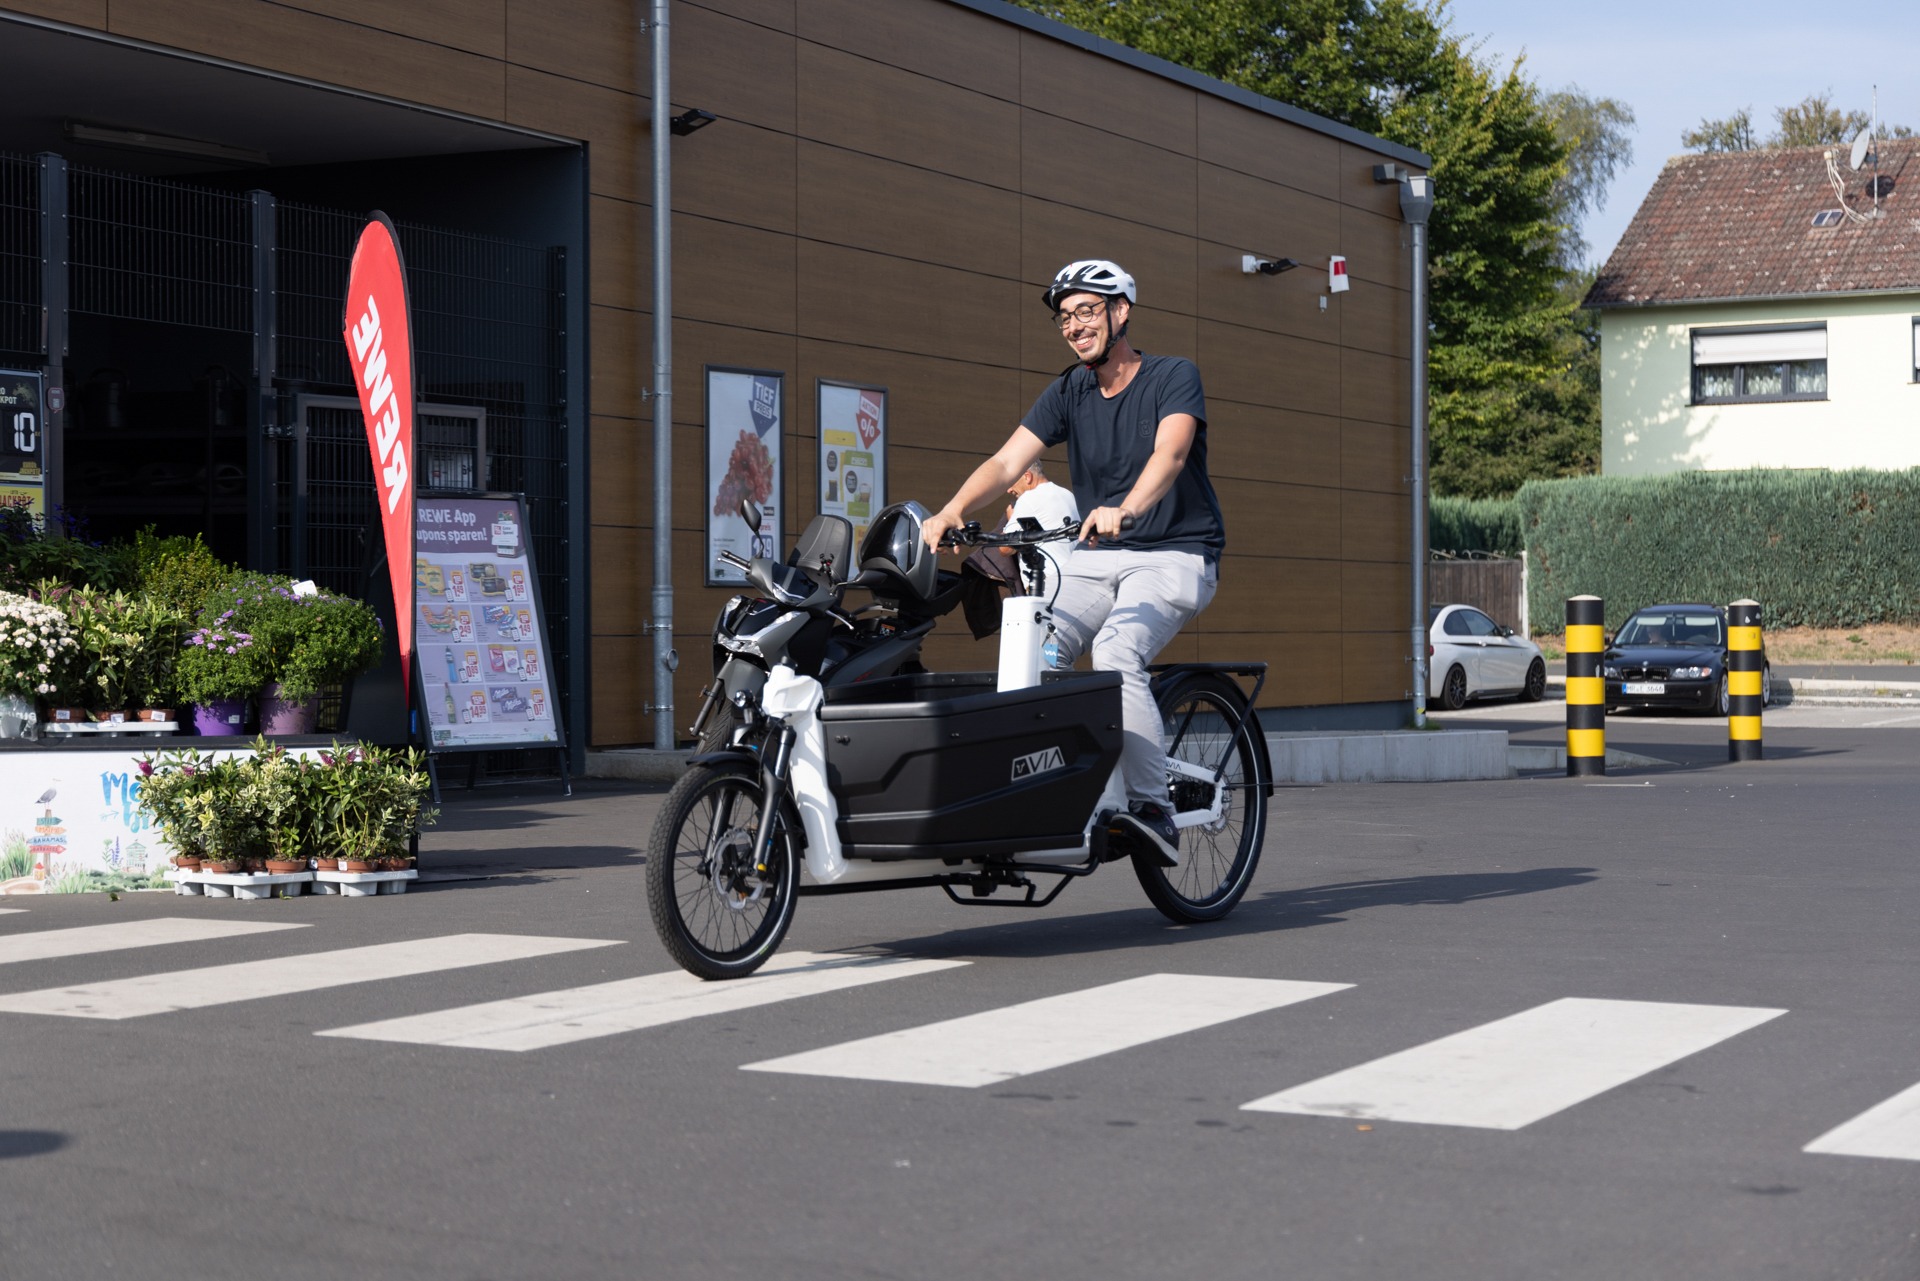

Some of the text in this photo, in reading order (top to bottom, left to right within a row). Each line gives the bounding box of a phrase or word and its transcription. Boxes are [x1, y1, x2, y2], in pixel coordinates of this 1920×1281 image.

[755, 381, 775, 405] TIEF
[756, 401, 771, 417] PREIS
[13, 412, 36, 453] 10
[419, 509, 476, 526] REWE App
[447, 527, 488, 544] sparen!
[1044, 649, 1057, 657] VIA
[1028, 749, 1064, 773] VIA
[1168, 760, 1182, 771] VIA
[33, 836, 63, 844] BAHAMAS
